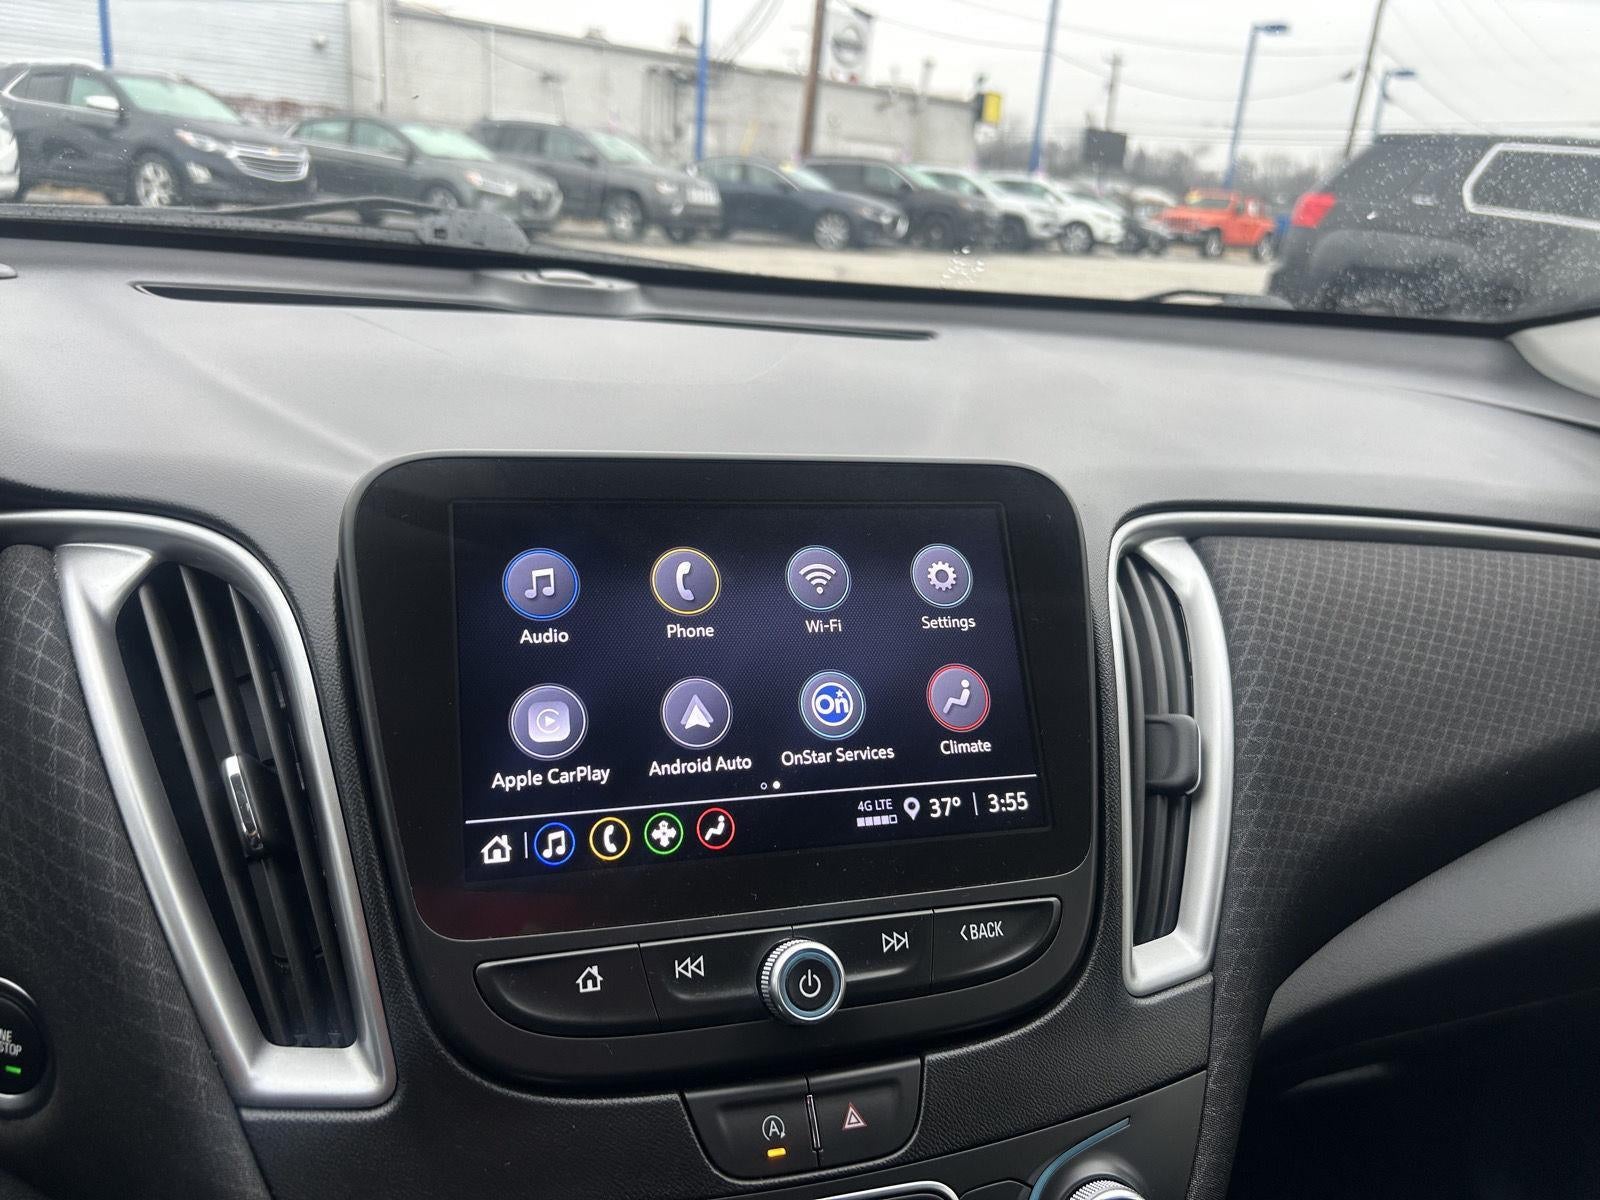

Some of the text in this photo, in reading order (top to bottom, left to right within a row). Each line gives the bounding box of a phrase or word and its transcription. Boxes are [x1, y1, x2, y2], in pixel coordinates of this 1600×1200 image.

[666, 624, 715, 639] Phone
[805, 618, 842, 633] Wi-Fi
[921, 616, 976, 632] Settings
[519, 628, 569, 644] Audio
[940, 739, 992, 755] Climate
[781, 746, 895, 766] OnStar Services
[649, 756, 752, 776] Android Auto
[491, 766, 610, 792] Apple CarPlay
[857, 798, 893, 812] 4G LTE
[987, 791, 1029, 812] 3:55
[969, 920, 1004, 940] BACK
